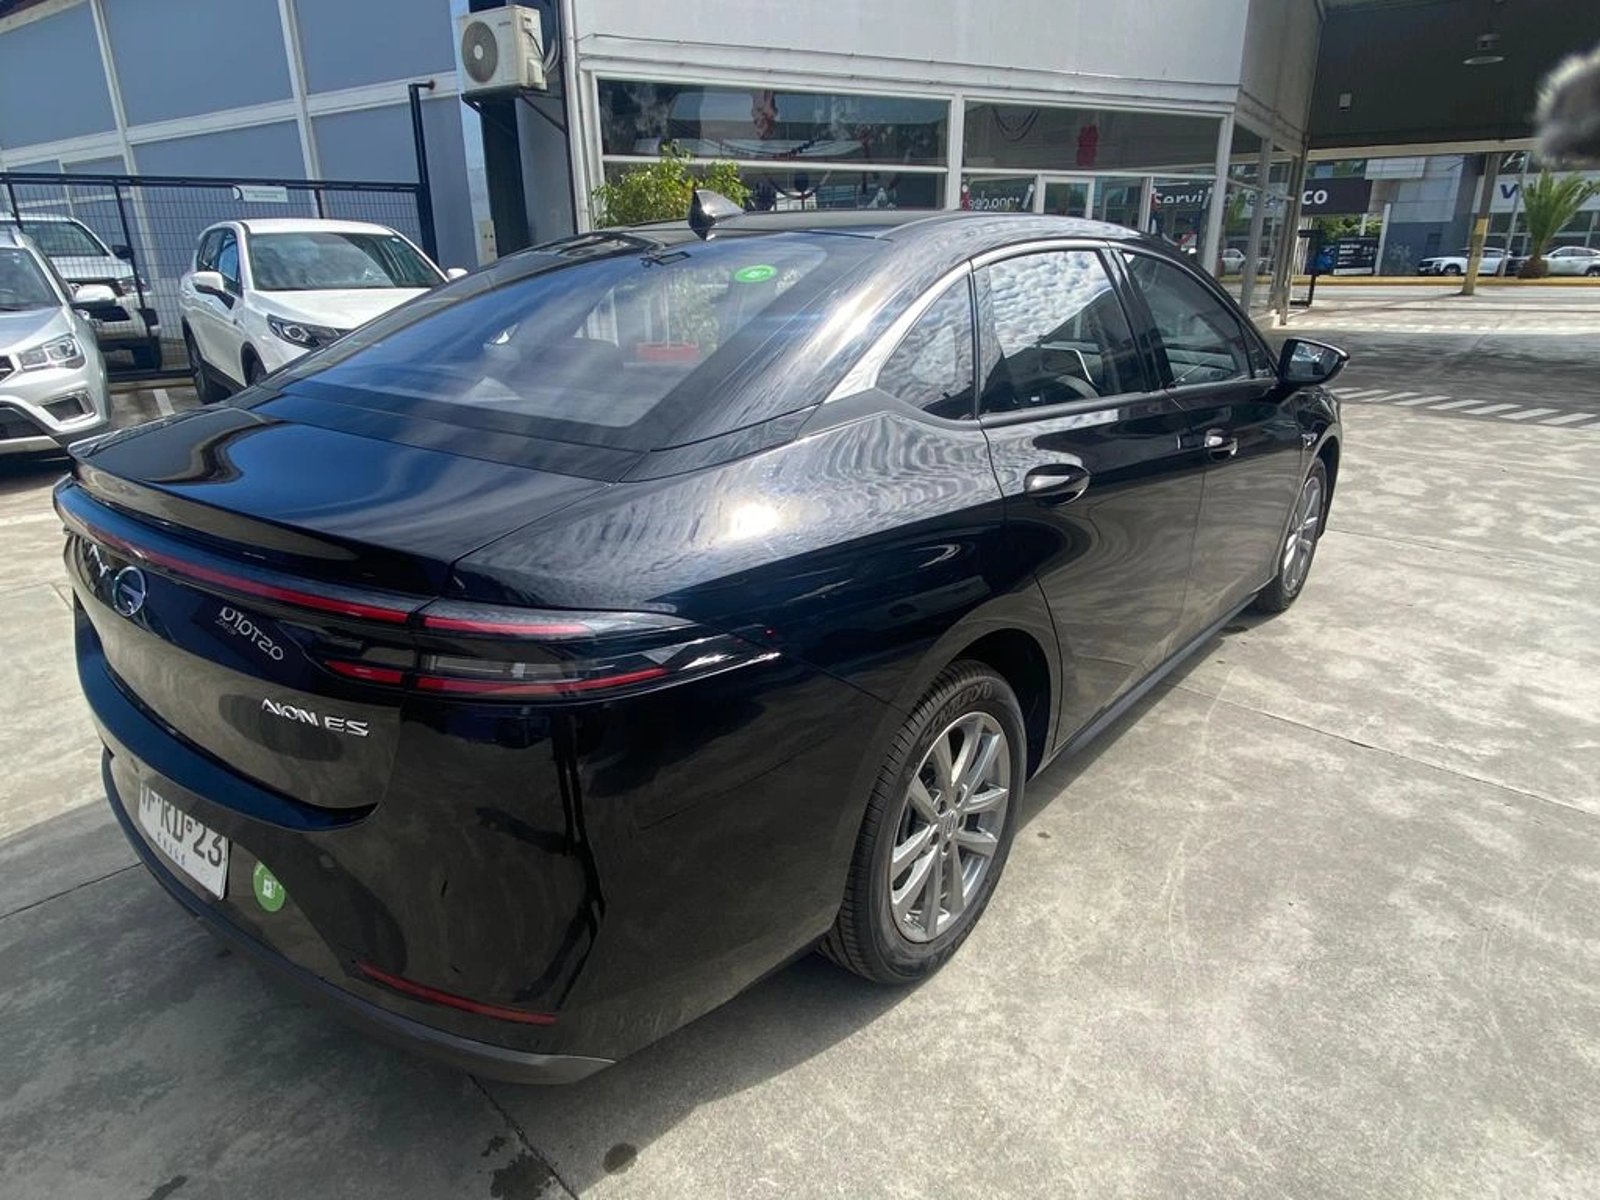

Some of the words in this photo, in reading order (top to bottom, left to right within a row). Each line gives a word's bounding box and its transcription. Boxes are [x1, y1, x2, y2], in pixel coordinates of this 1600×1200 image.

[1302, 190, 1328, 205] co
[261, 698, 319, 727] AION
[324, 716, 370, 737] ES
